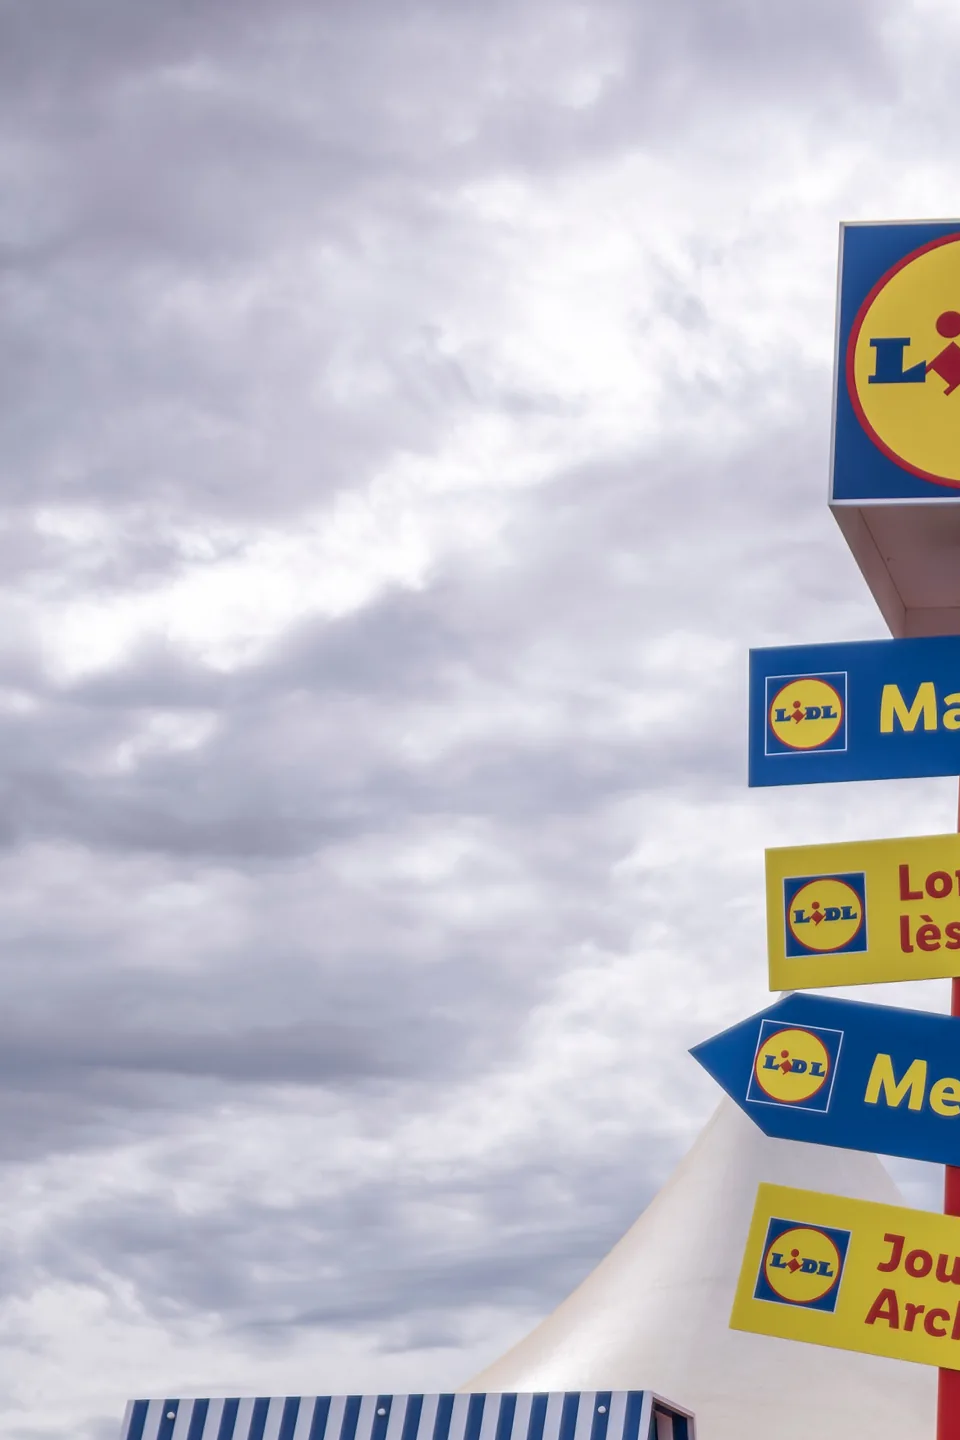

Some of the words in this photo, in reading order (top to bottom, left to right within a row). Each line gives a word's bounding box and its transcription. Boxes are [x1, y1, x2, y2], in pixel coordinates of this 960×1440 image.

[774, 700, 838, 725] LIDL
[793, 900, 858, 926] LIDL
[762, 1050, 826, 1079] LIDL
[769, 1248, 835, 1278] LIDL
